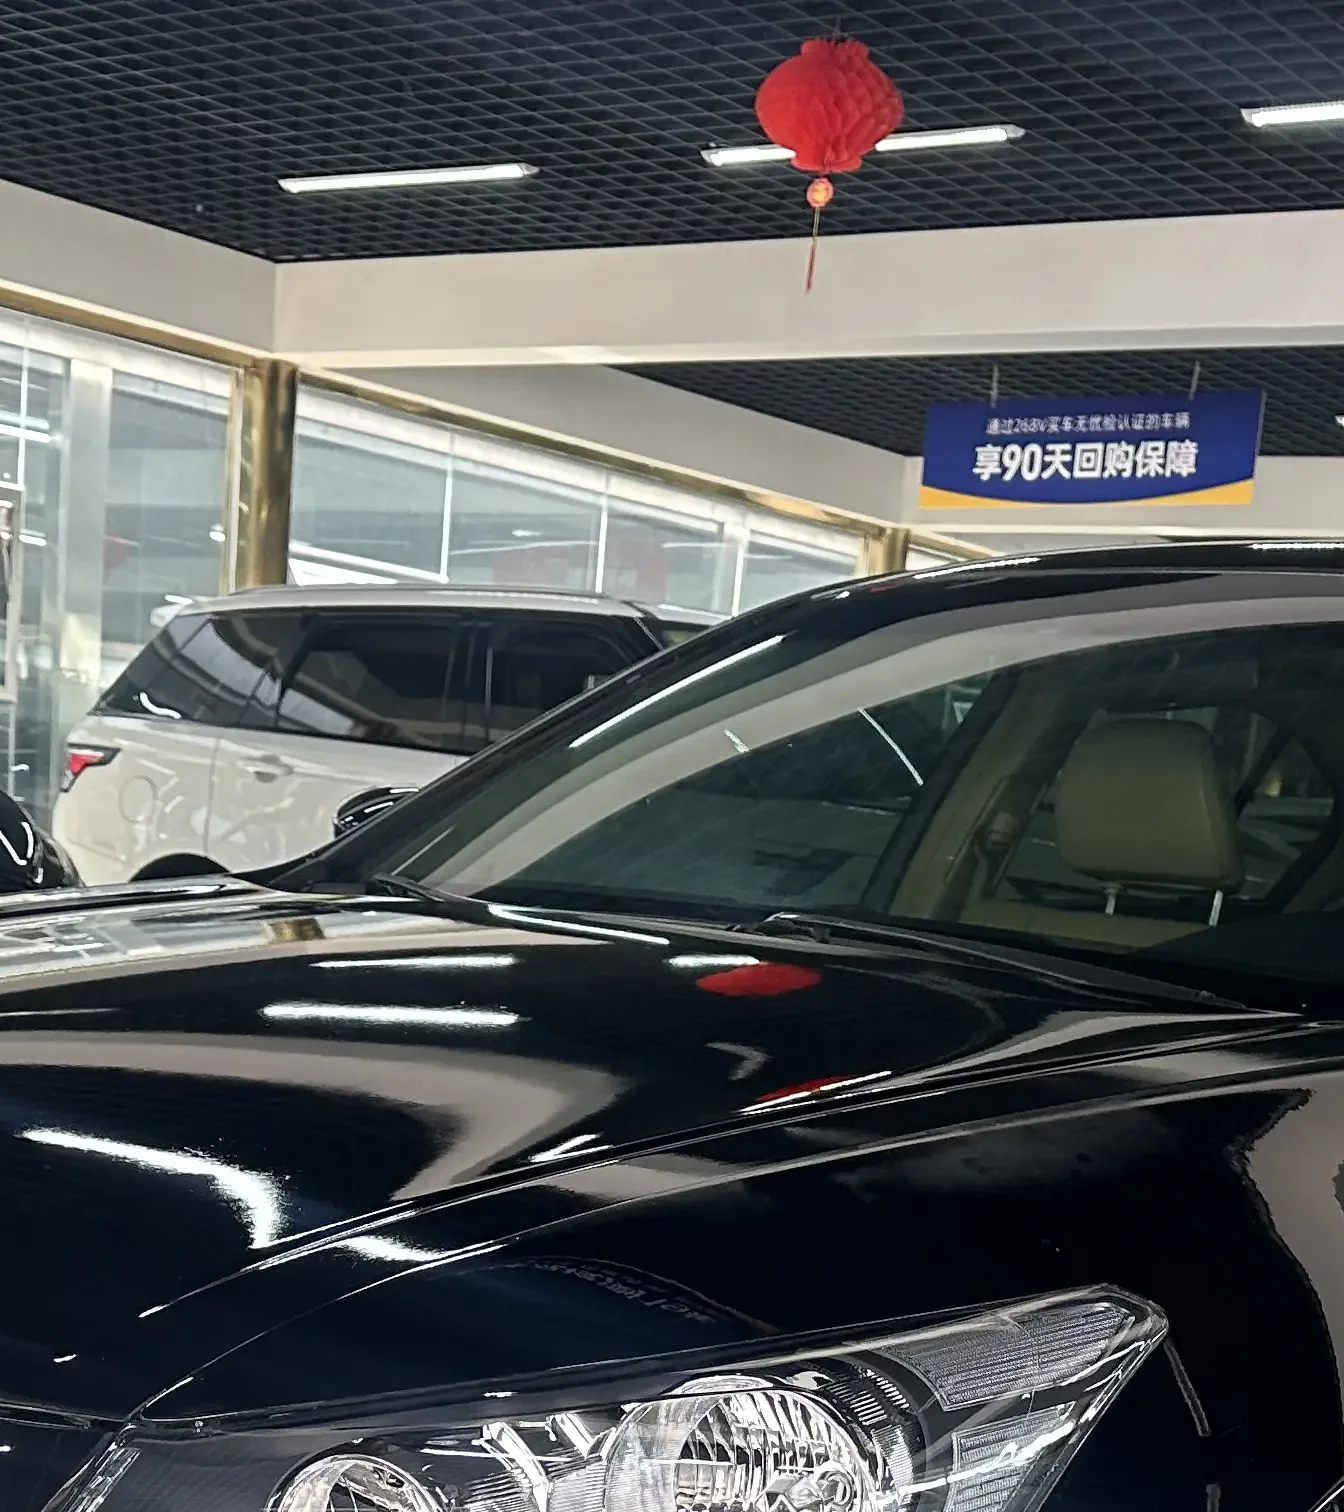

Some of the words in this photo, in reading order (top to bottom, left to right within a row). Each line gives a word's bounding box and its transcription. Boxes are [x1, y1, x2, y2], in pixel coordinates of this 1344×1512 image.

[972, 439, 1199, 482] 享90天回购保障
